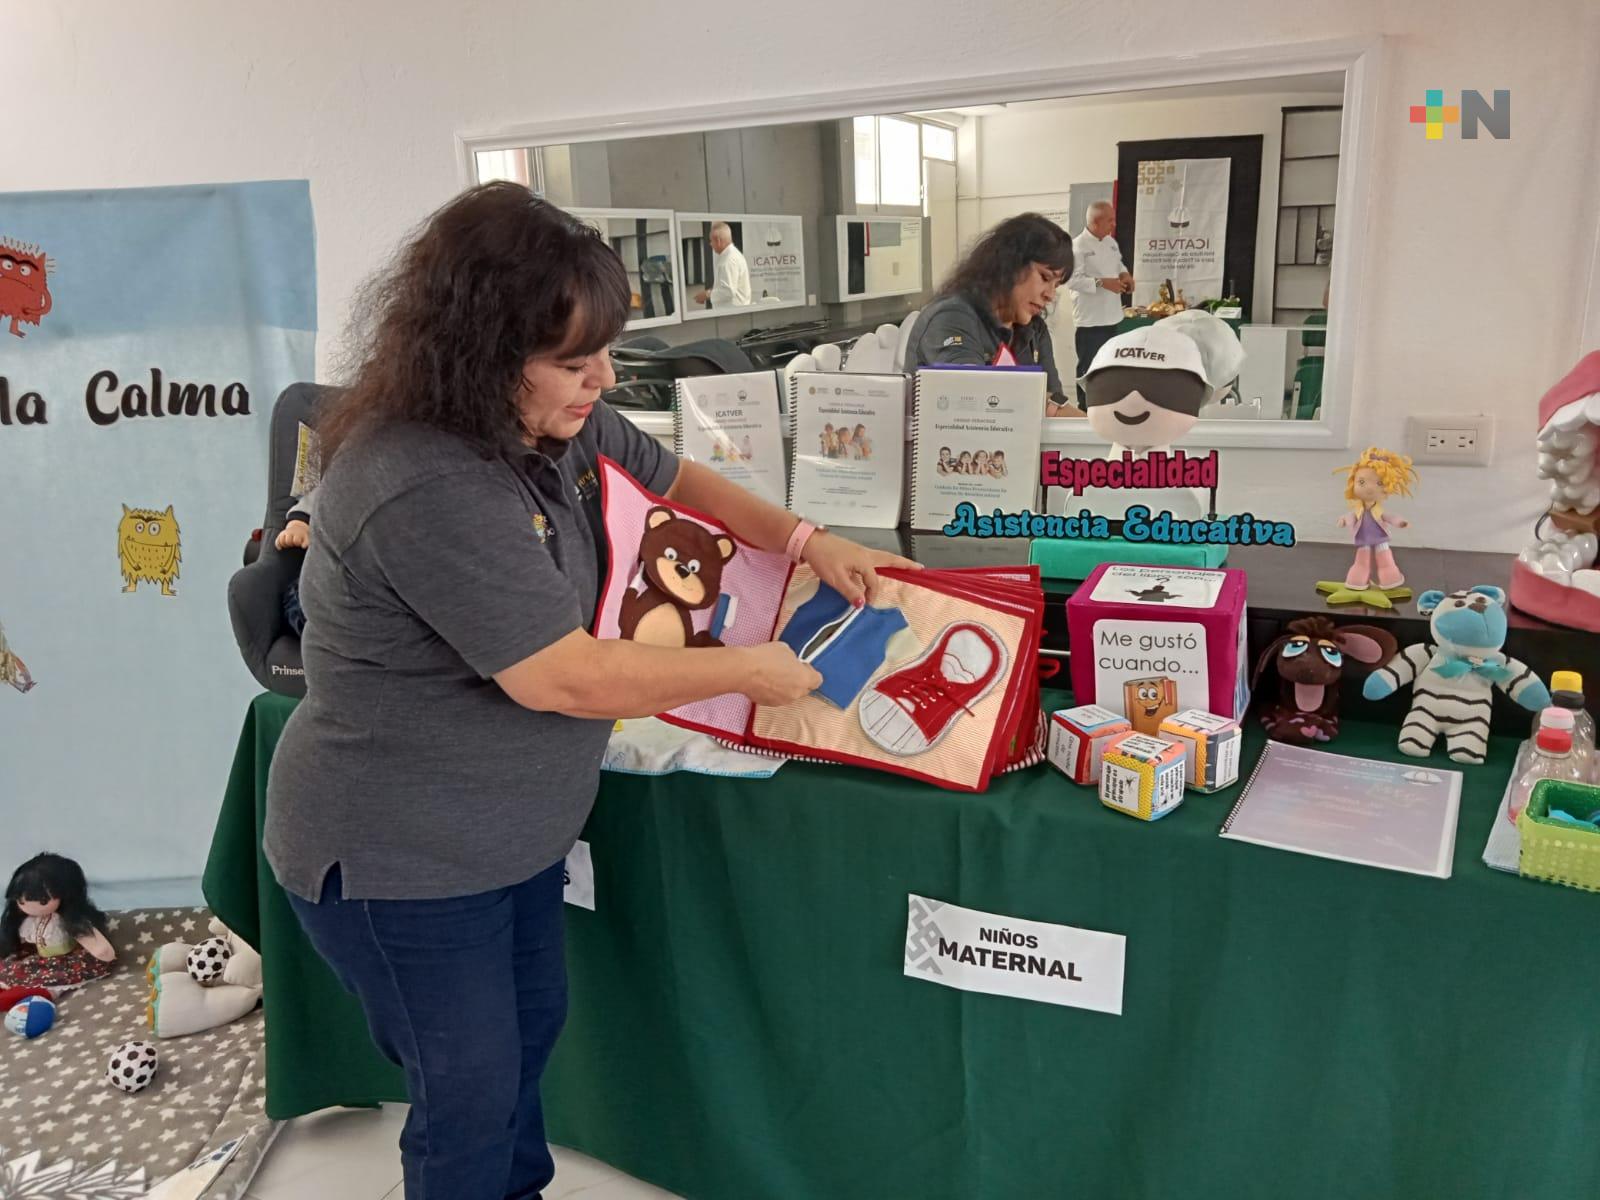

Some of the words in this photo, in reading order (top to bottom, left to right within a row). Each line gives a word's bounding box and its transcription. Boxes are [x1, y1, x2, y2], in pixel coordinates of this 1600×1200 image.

[753, 255, 797, 266] ICATVER
[1114, 347, 1166, 362] ICATVER
[86, 368, 252, 426] Calma
[1040, 450, 1219, 496] Especialidad
[944, 502, 1110, 539] Asistencia
[1122, 505, 1296, 547] Educativa
[1100, 631, 1133, 647] Me
[1139, 632, 1198, 652] gustó
[1098, 656, 1200, 675] cuando...
[979, 927, 1039, 949] NIÑOS
[937, 937, 1083, 982] MATERNAL
